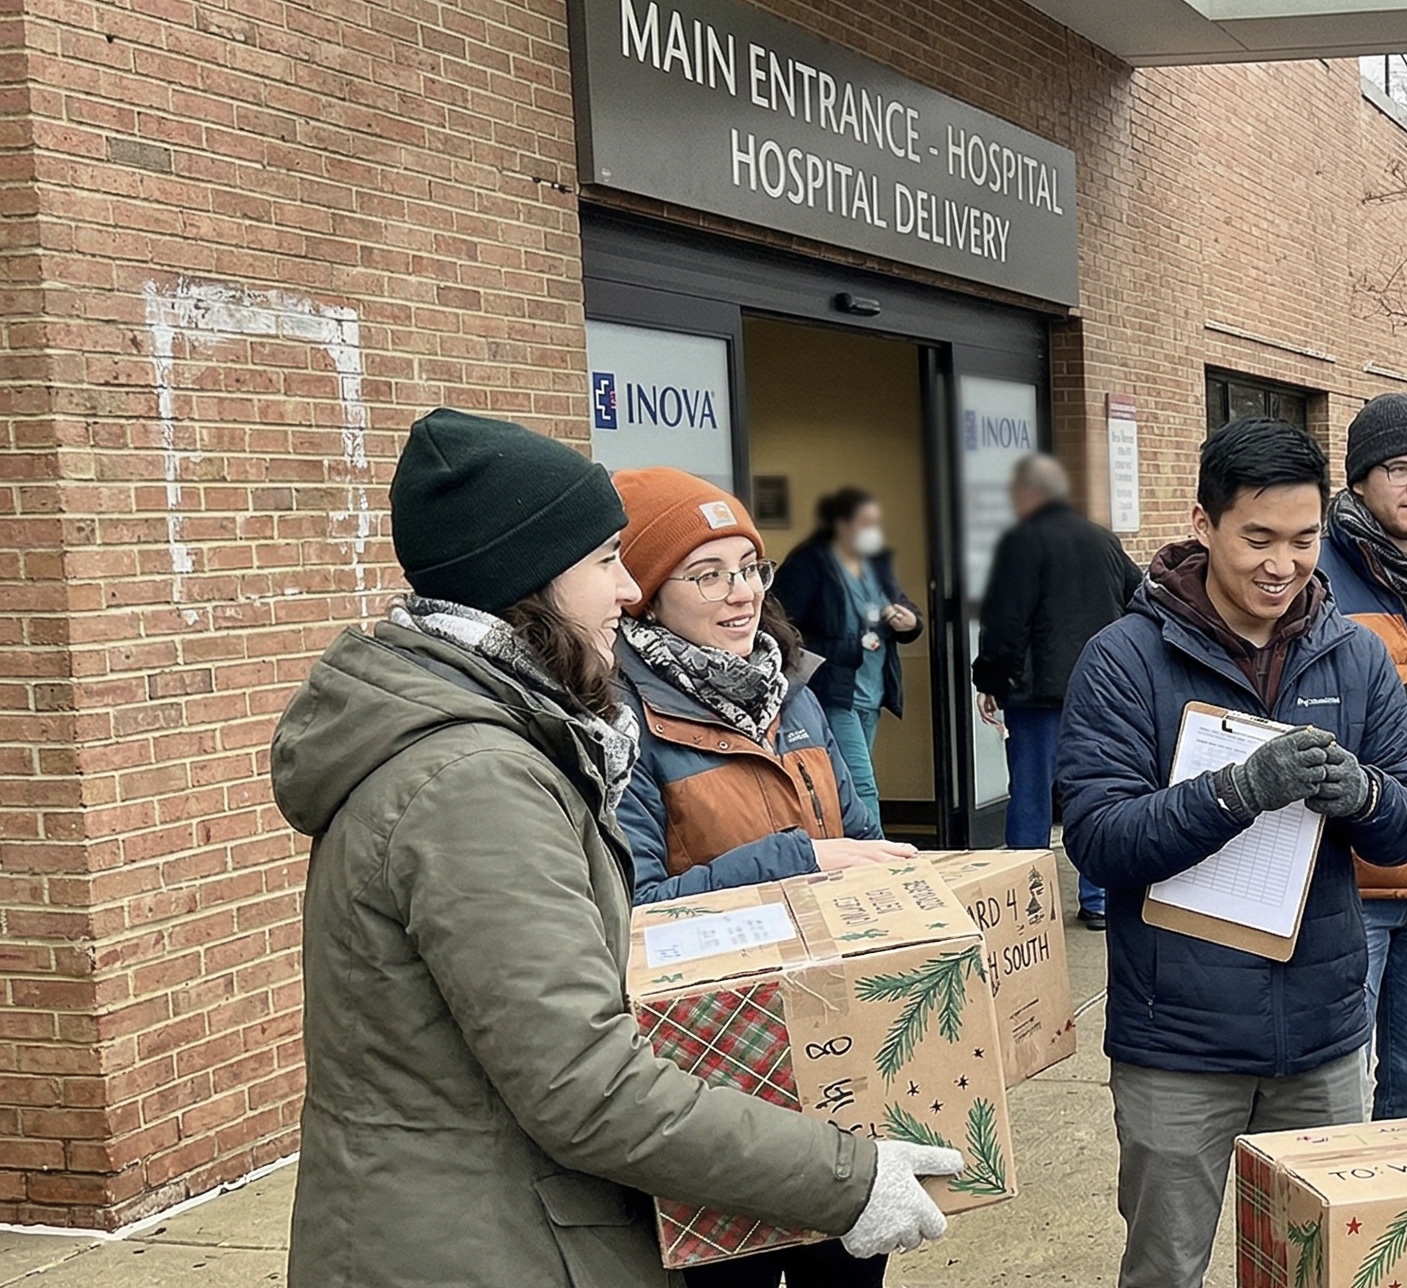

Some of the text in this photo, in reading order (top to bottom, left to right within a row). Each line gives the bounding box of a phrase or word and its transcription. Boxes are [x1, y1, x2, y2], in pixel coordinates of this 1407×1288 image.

[621, 0, 1064, 216] MAIN ENTRANCE - HOSPITAL
[730, 127, 1010, 263] HOSPITAL DELIVERY
[626, 382, 718, 430] INOVA
[981, 415, 1031, 450] INOVA
[1006, 888, 1018, 922] 4
[1003, 931, 1050, 976] SOUTH
[1328, 1166, 1384, 1182] TO:
